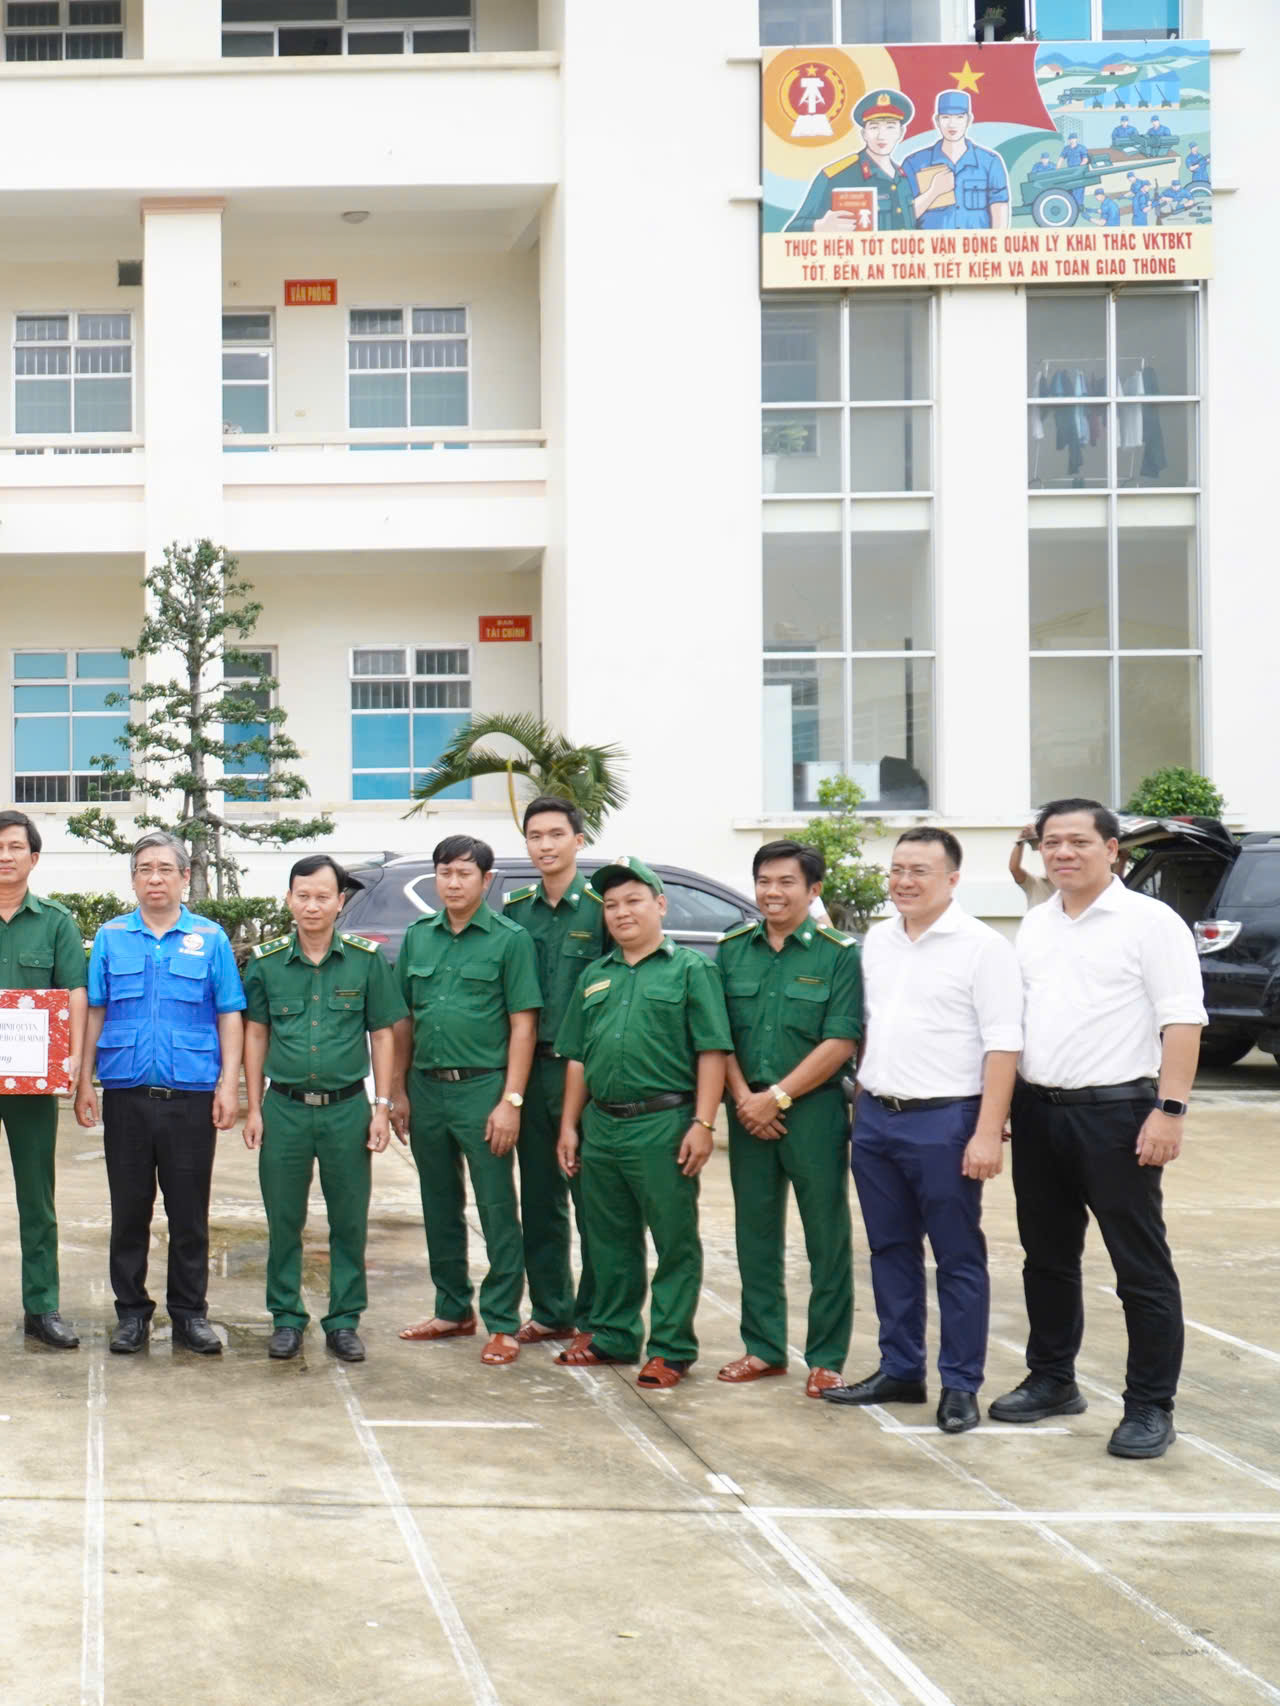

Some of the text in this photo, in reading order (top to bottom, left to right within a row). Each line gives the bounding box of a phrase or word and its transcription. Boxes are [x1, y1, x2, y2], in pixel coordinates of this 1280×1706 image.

[1066, 234, 1096, 252] KHAI
[1142, 232, 1193, 250] VKTBKT
[867, 263, 885, 279] AN
[1031, 260, 1048, 277] AN
[1096, 259, 1126, 275] GIAO
